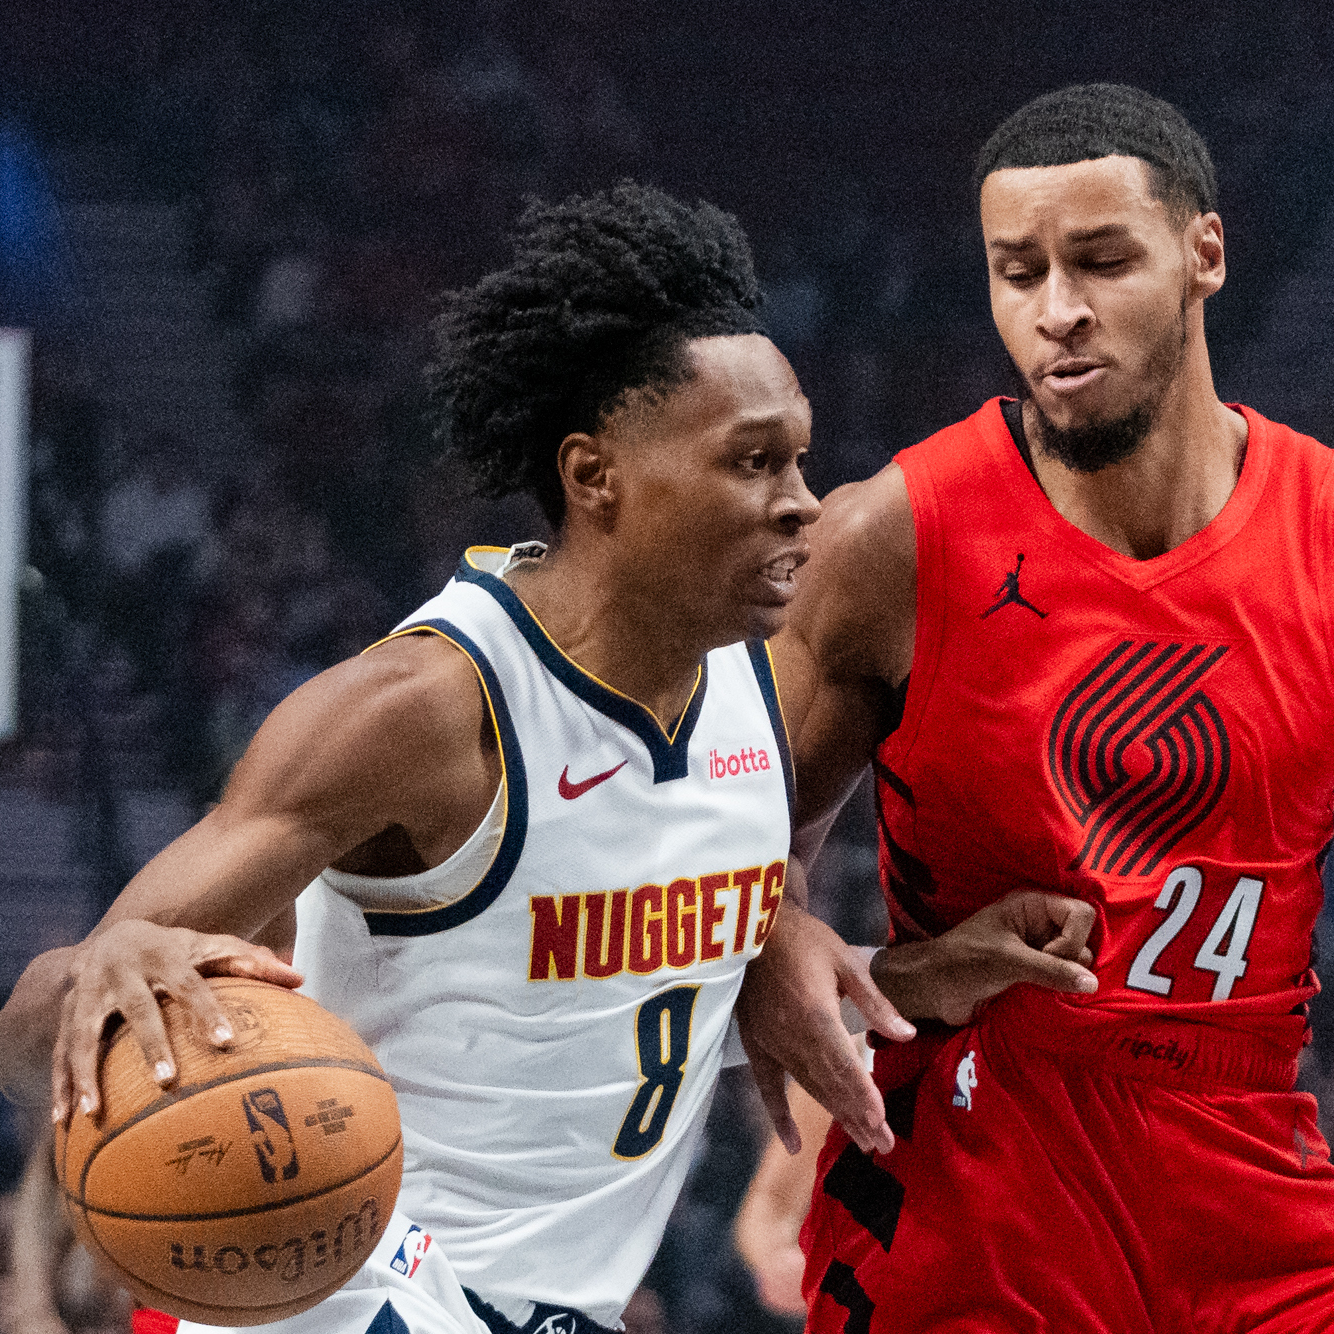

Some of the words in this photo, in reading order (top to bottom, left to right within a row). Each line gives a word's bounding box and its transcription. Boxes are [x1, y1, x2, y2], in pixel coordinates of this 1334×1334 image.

[709, 746, 771, 779] ibotta
[527, 859, 788, 982] NUGGETS
[1126, 866, 1264, 1003] 24
[611, 983, 703, 1162] 8
